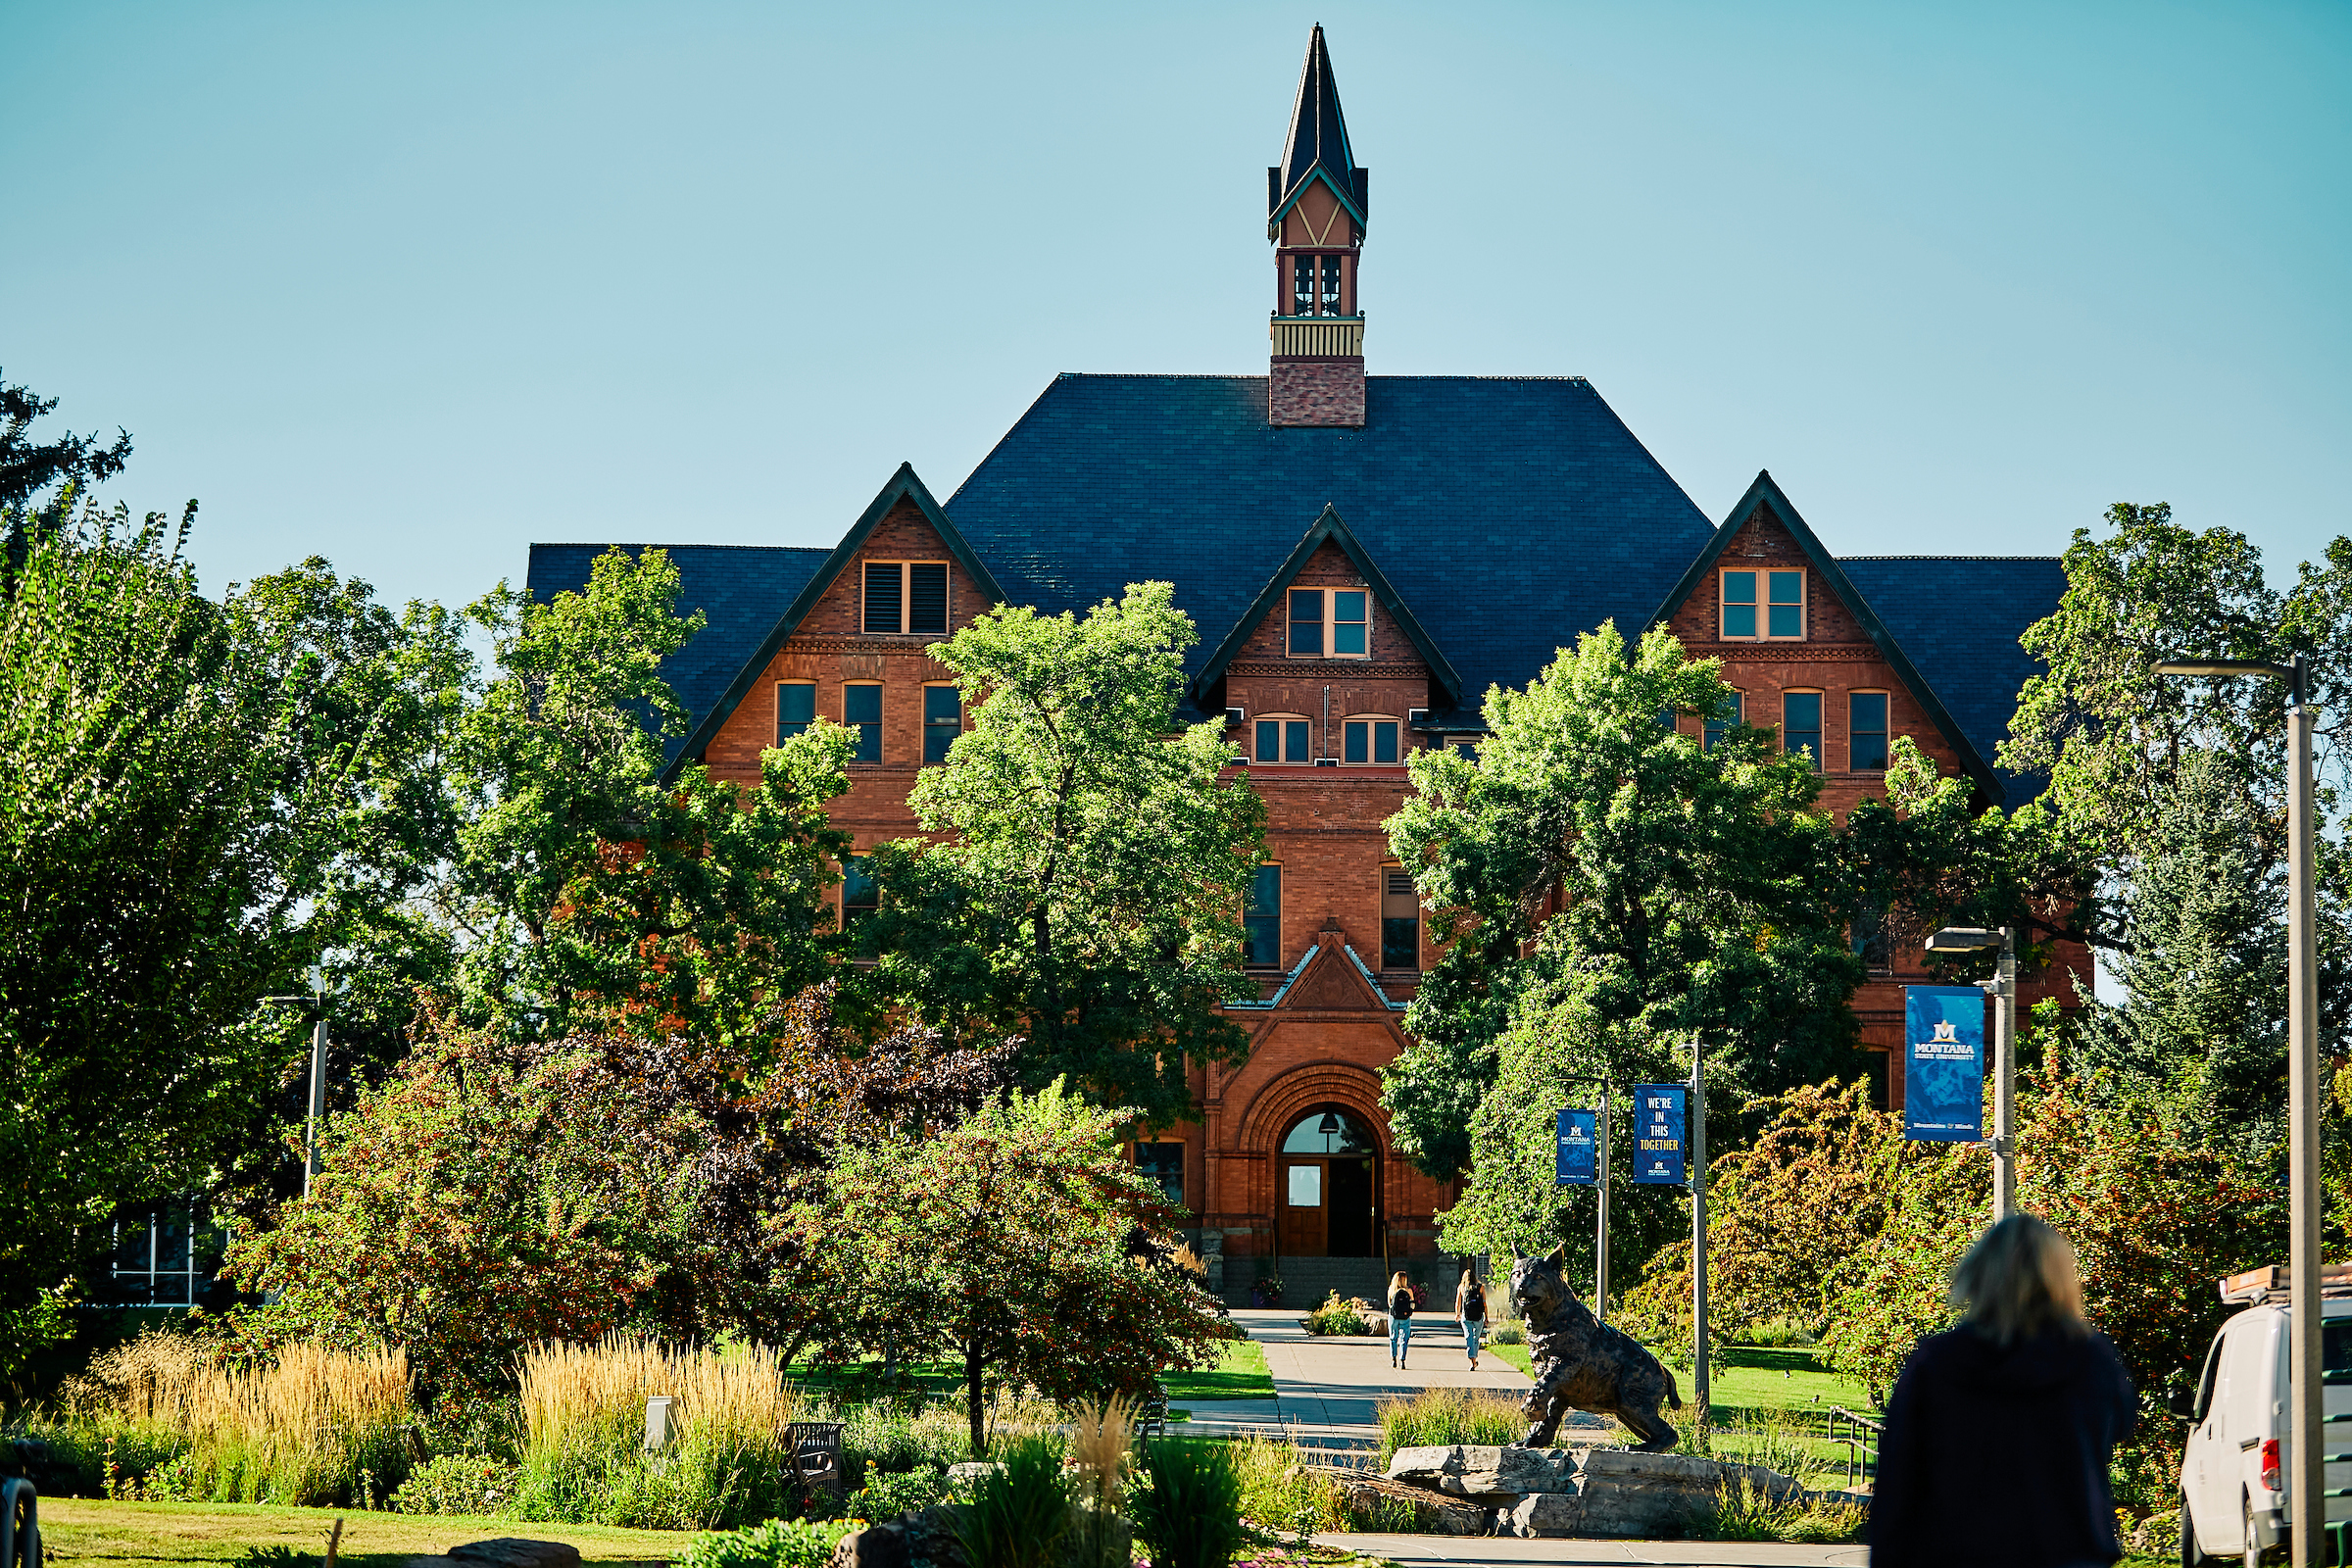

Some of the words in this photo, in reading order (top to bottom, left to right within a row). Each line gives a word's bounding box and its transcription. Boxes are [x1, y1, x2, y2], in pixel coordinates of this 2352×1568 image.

[1914, 1044, 1975, 1054] MONTANA
[1647, 1098, 1672, 1109] WE'RE
[1655, 1111, 1665, 1122] IN
[1650, 1125, 1669, 1137] THIS
[1640, 1140, 1679, 1151] TOGETHER
